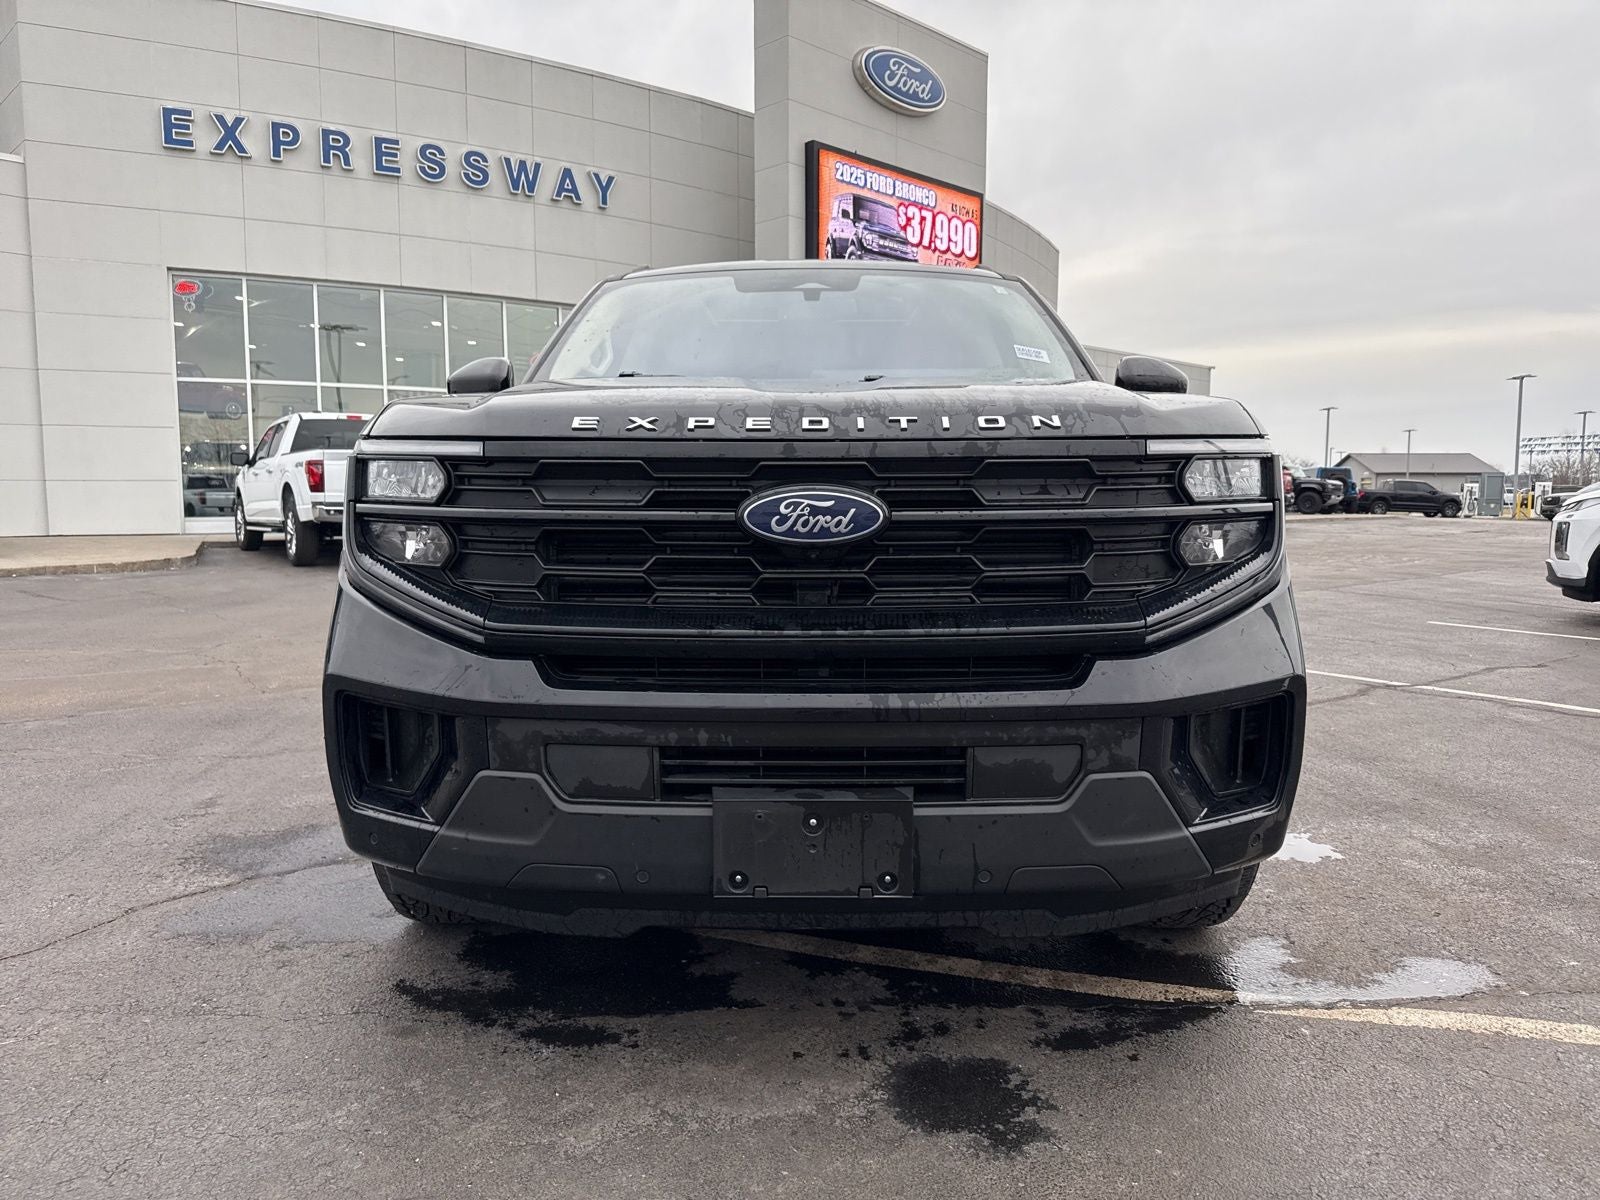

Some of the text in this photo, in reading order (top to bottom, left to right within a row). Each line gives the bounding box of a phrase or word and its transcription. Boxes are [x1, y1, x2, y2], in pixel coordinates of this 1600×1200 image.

[885, 58, 932, 100] Ford
[160, 105, 617, 208] EXPRESSWAY
[835, 161, 937, 208] 2025 FORD BRONCO
[571, 415, 1064, 433] EXPEDITION
[769, 499, 855, 534] Ford
